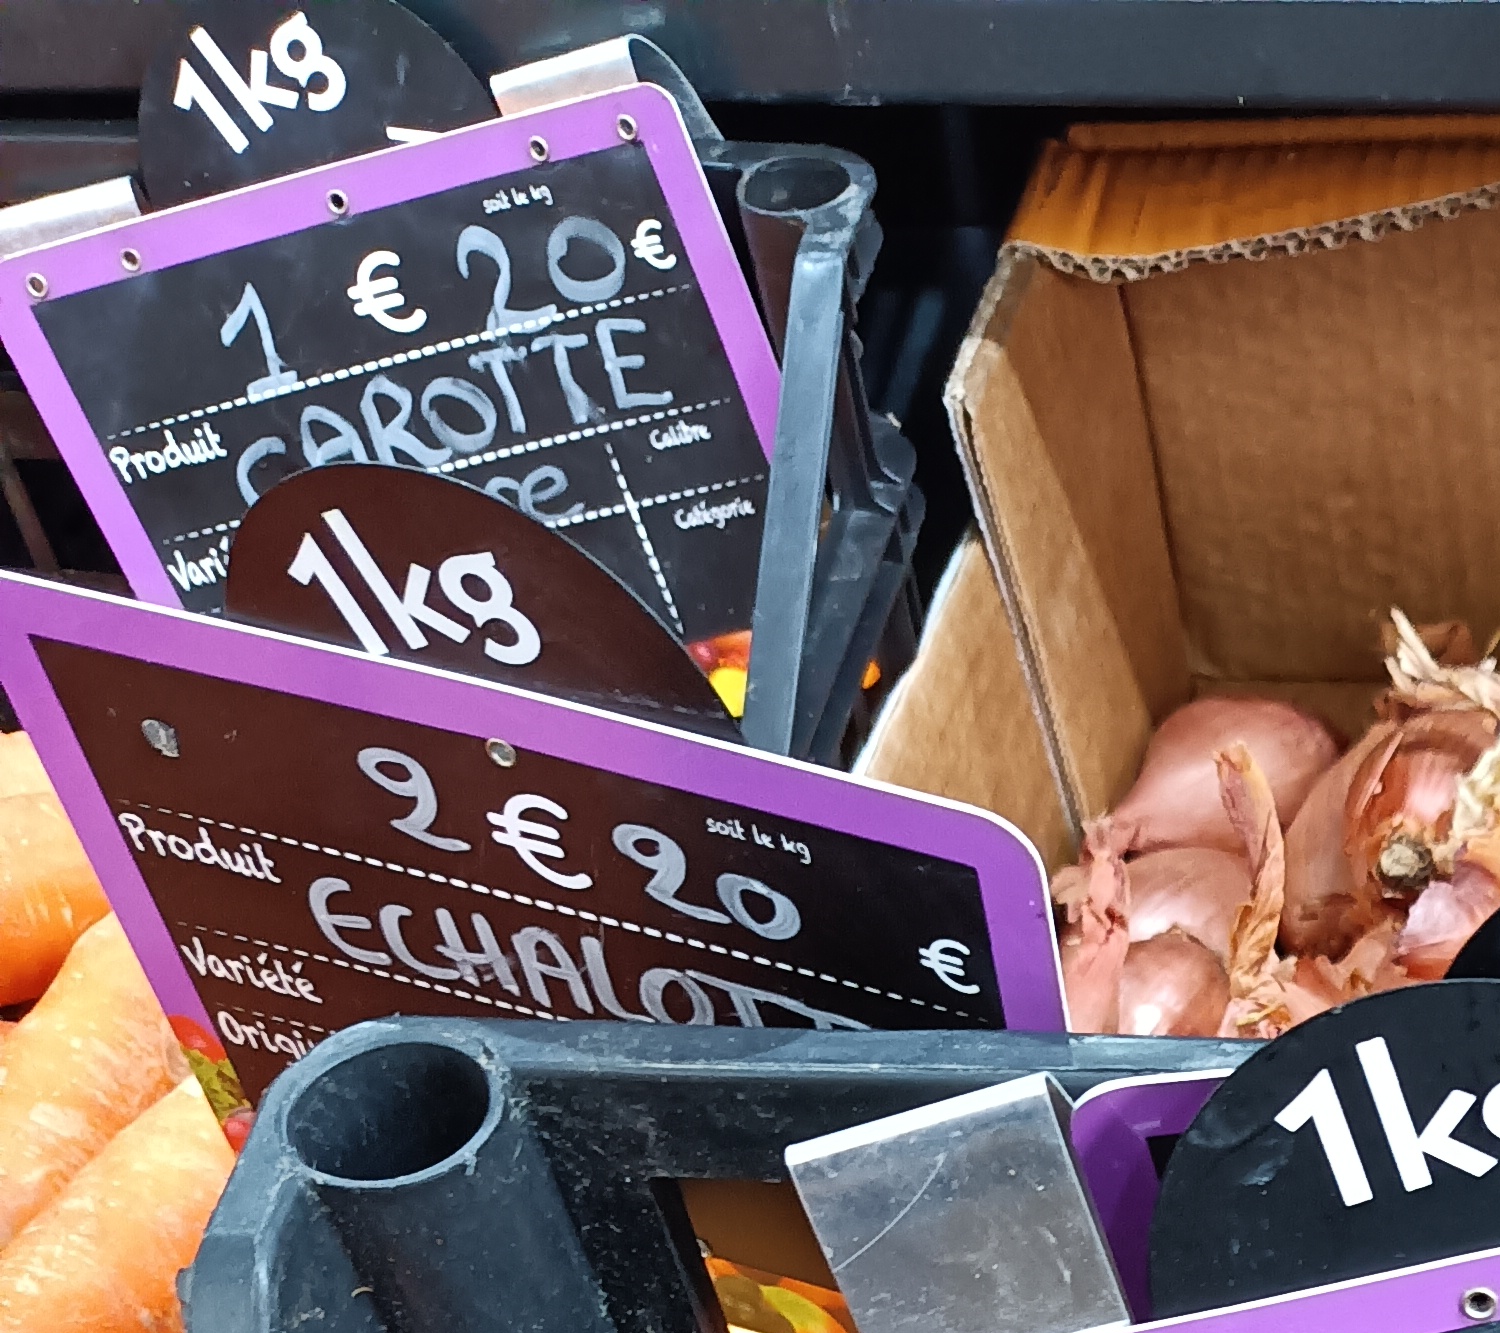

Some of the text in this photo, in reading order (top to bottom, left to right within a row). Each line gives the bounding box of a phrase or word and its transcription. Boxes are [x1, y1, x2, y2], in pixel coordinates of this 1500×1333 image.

[173, 10, 347, 154] 1kg
[220, 215, 677, 402] 1 € 20 €
[109, 422, 227, 484] Produit
[236, 318, 674, 508] CAROTTE
[650, 420, 712, 450] Calibre
[674, 497, 756, 530] Catégorie
[167, 535, 229, 592] Vari
[287, 508, 541, 666] 1kg
[118, 813, 282, 883] Produit
[357, 747, 981, 995] 2 € 20 €
[706, 817, 812, 865] soit le kg
[180, 936, 323, 1004] Variété
